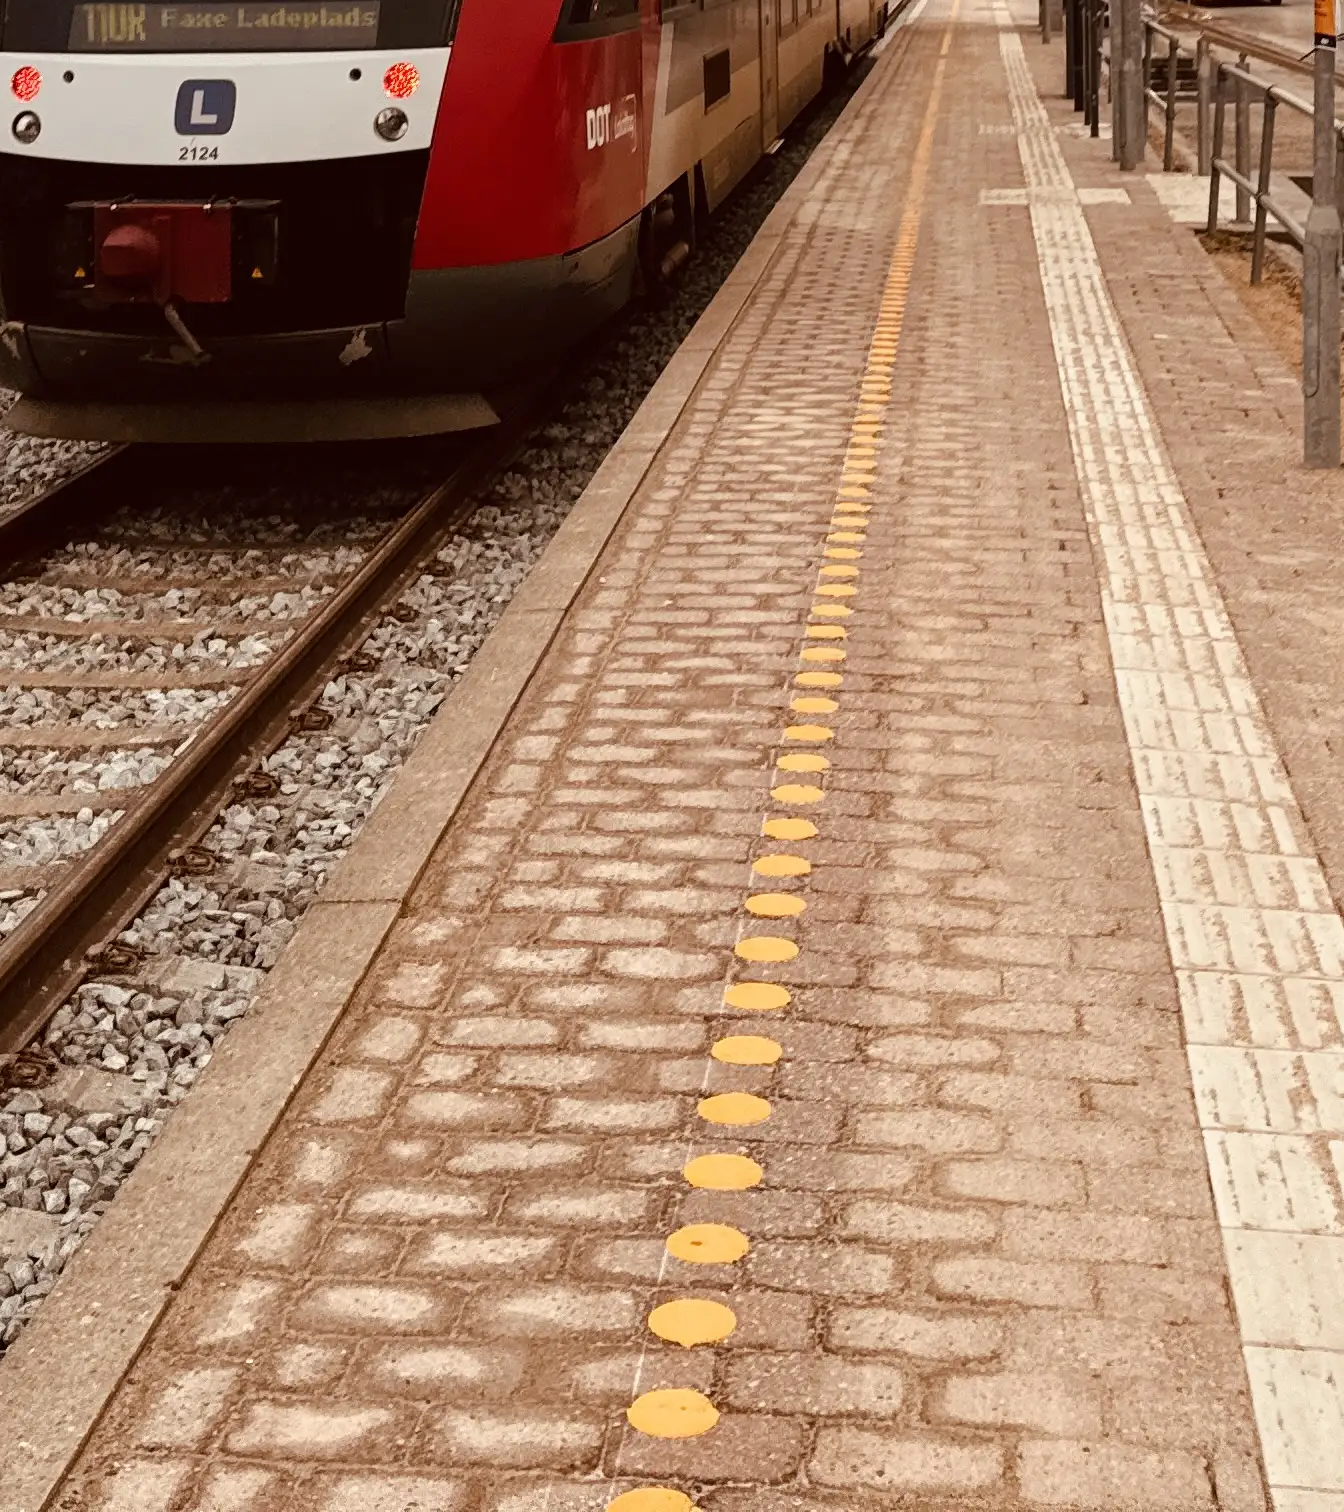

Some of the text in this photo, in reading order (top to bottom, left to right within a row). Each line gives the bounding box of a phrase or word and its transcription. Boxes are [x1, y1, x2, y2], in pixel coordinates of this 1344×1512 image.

[190, 90, 218, 125] L
[586, 102, 611, 150] DOT
[178, 146, 219, 161] 2124
